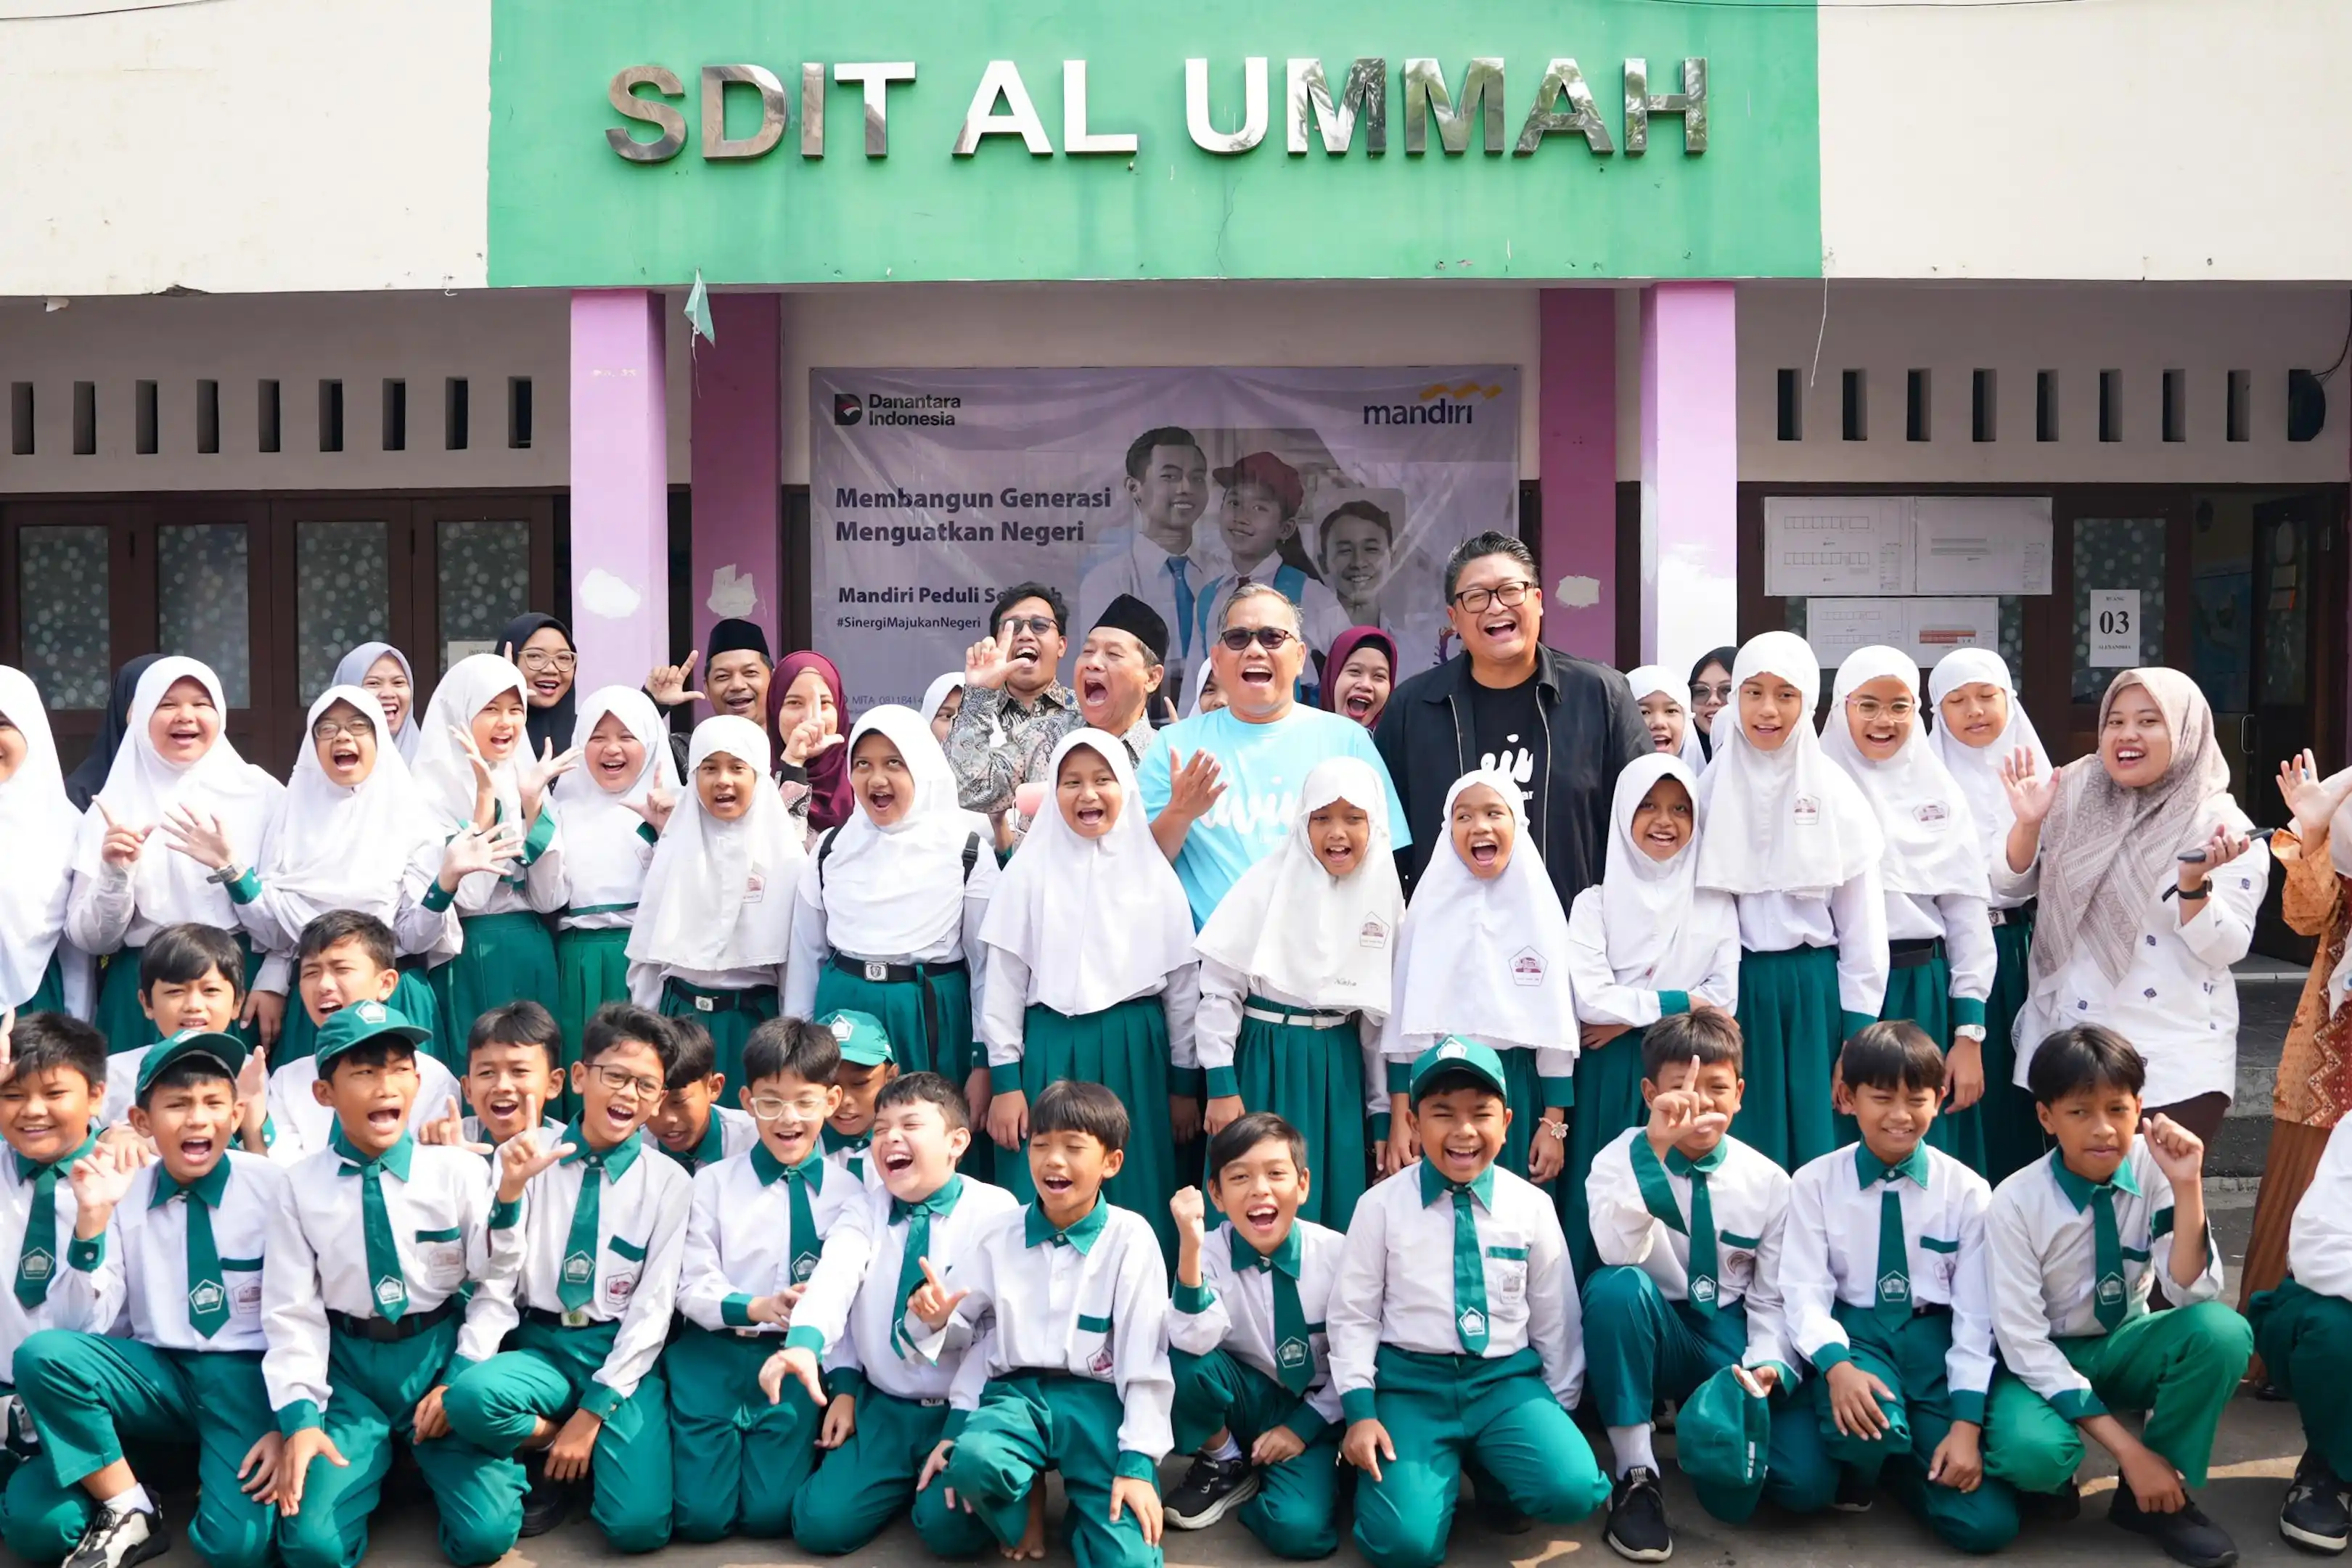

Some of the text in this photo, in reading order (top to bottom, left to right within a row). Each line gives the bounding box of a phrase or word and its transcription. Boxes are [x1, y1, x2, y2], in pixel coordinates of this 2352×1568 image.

[605, 57, 1708, 163] SDIT AL UMMAH
[869, 393, 961, 409] Danantara
[869, 410, 955, 426] Indonesia
[835, 487, 1111, 513] Membangun Generasi
[835, 520, 1084, 546] Menguatkan Negeri
[839, 587, 914, 603] Mandiri
[919, 587, 980, 603] Peduli
[837, 616, 981, 631] #SinergiMajukanNegeri
[2099, 610, 2129, 634] 03
[852, 695, 875, 705] MITA
